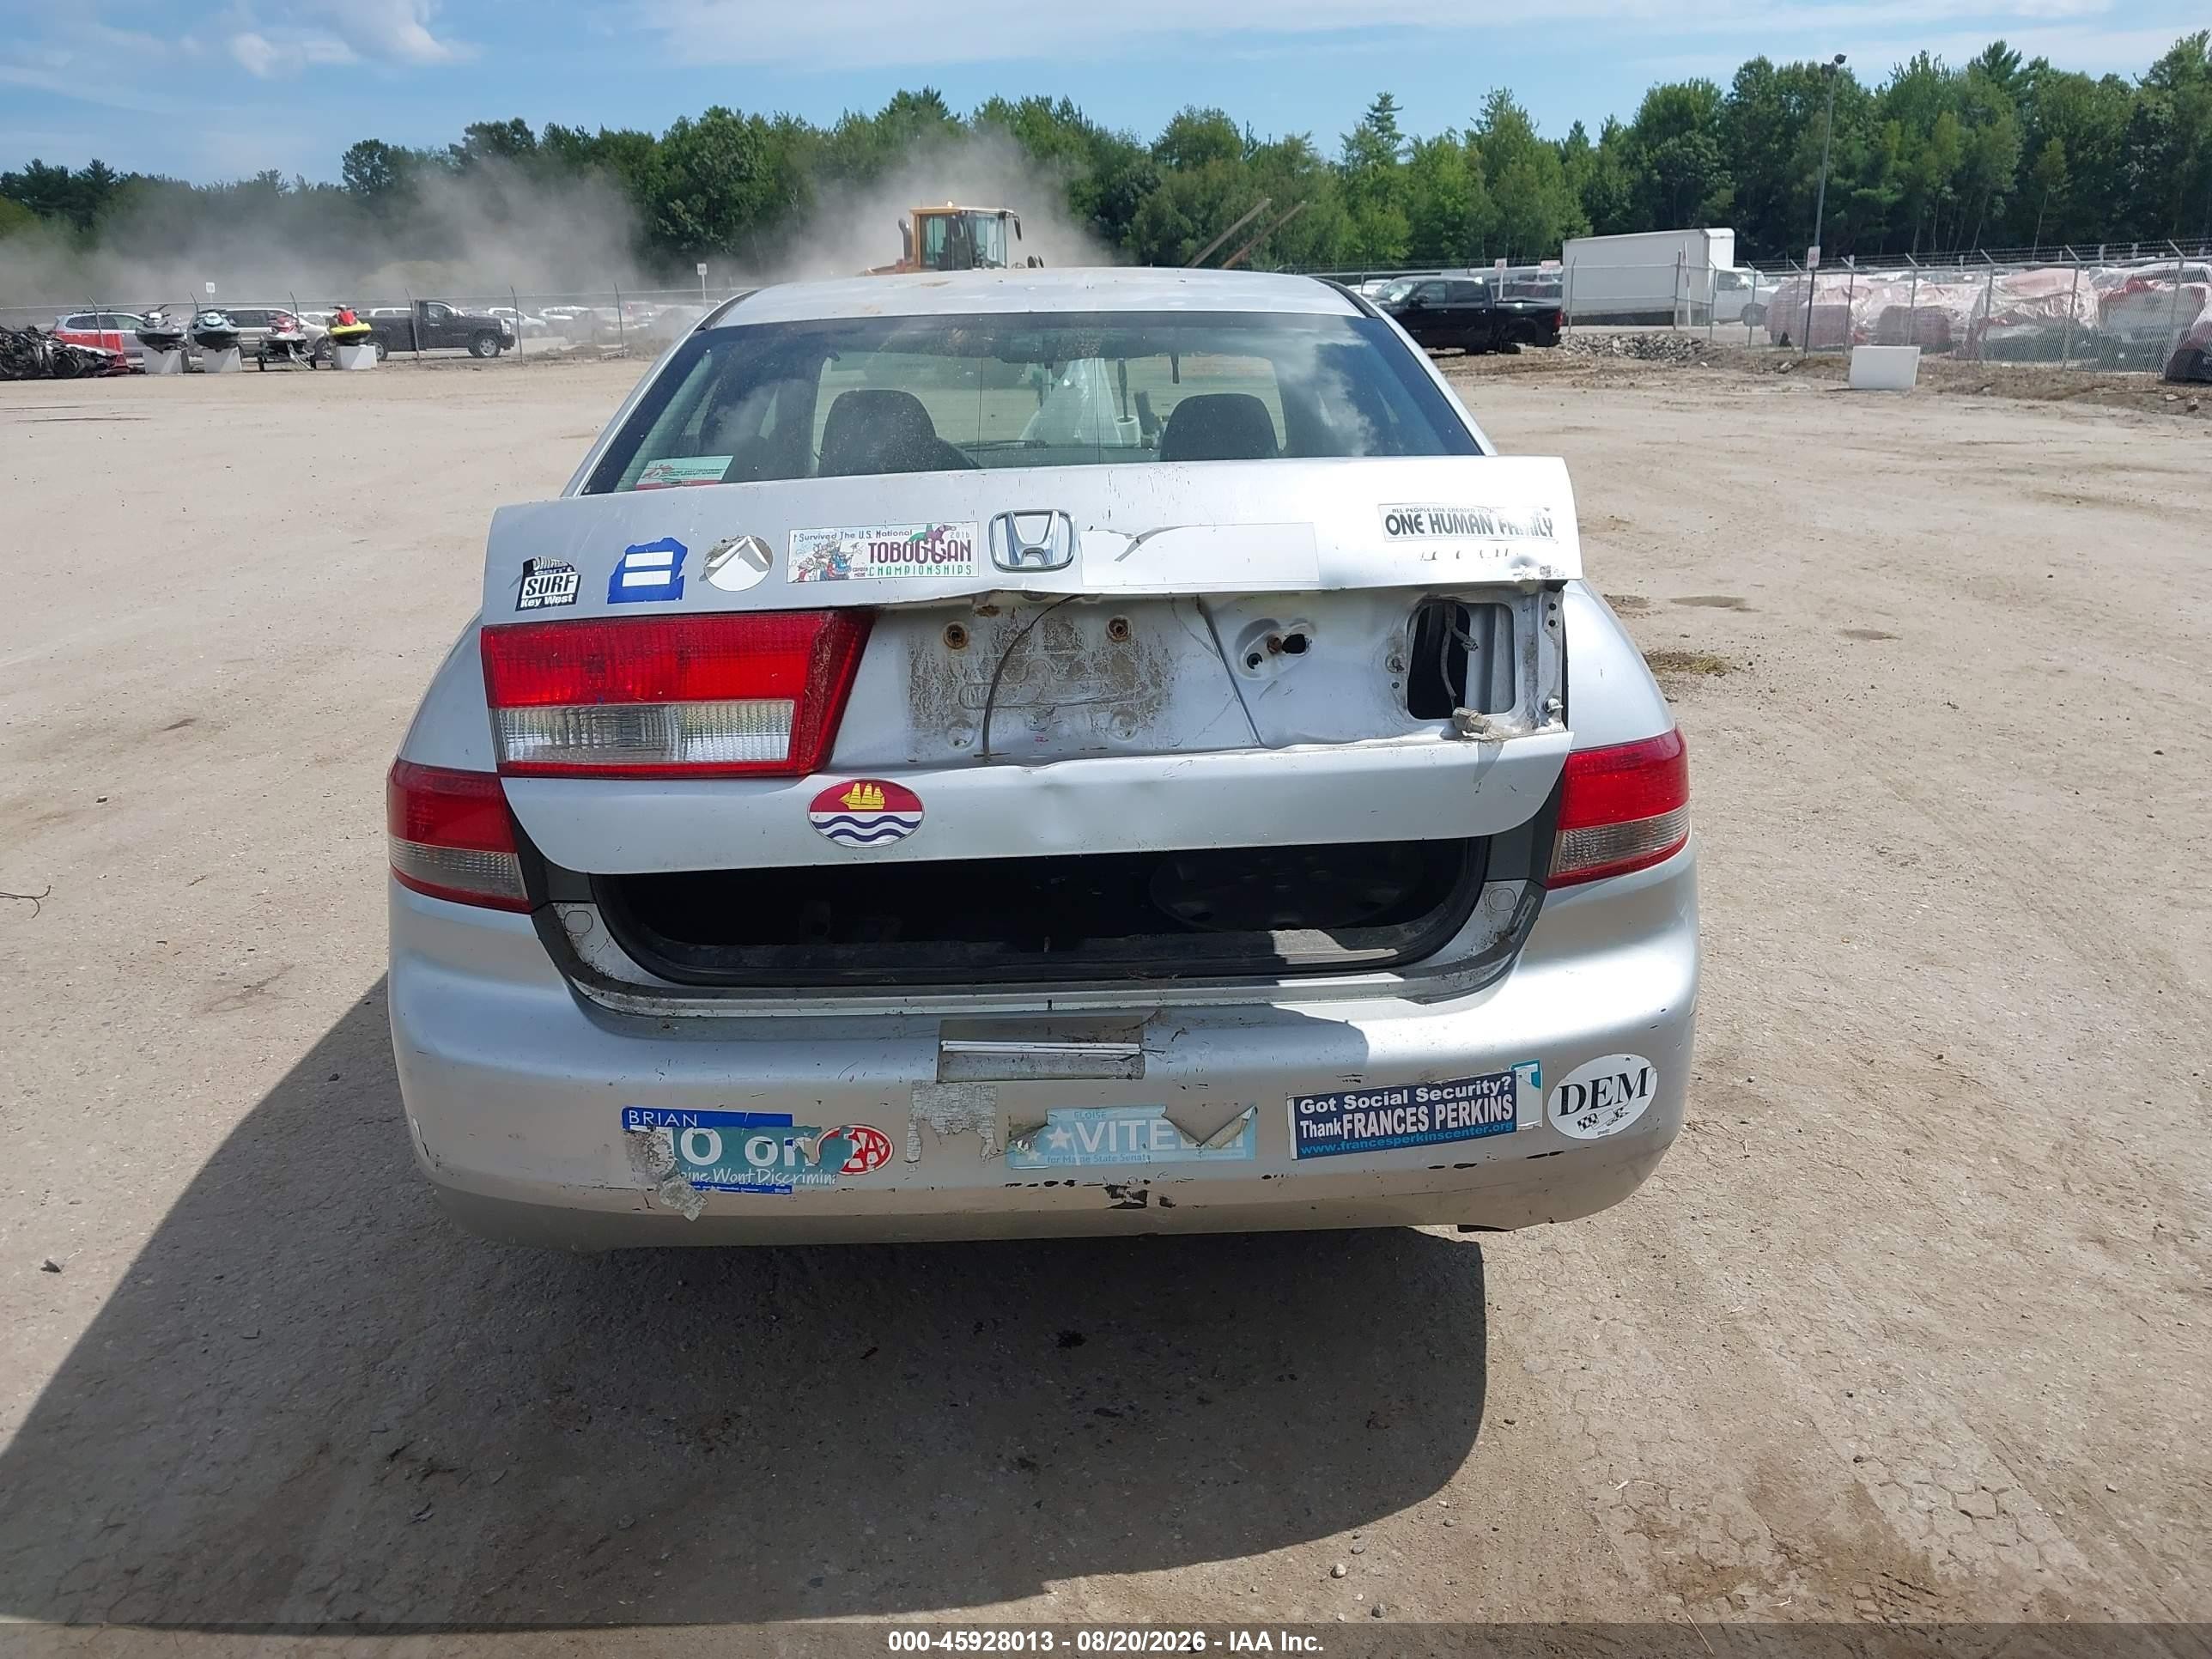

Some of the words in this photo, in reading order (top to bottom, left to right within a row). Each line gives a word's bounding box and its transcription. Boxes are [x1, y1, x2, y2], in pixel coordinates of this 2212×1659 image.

[841, 531, 855, 539] The
[860, 530, 872, 539] U.S.
[876, 529, 913, 538] National
[1385, 514, 1425, 535] ONE
[1428, 513, 1494, 535] HUMAN
[868, 539, 971, 564] TOBOGGAN
[869, 564, 971, 576] CHAMPIONSHIPS
[526, 574, 574, 596] SURF
[520, 598, 542, 607] Key
[544, 594, 574, 605] West
[1299, 1096, 1336, 1115] Got
[1343, 1089, 1408, 1110] Social
[1416, 1075, 1511, 1100] Security?
[1558, 1066, 1650, 1117] DEM
[629, 1109, 697, 1127] BRIAN
[1299, 1116, 1343, 1139] Thank
[1343, 1106, 1429, 1140] FRANCES
[1435, 1094, 1513, 1130] PERKINS
[1300, 1121, 1513, 1156] www.francesperkinscenter.org
